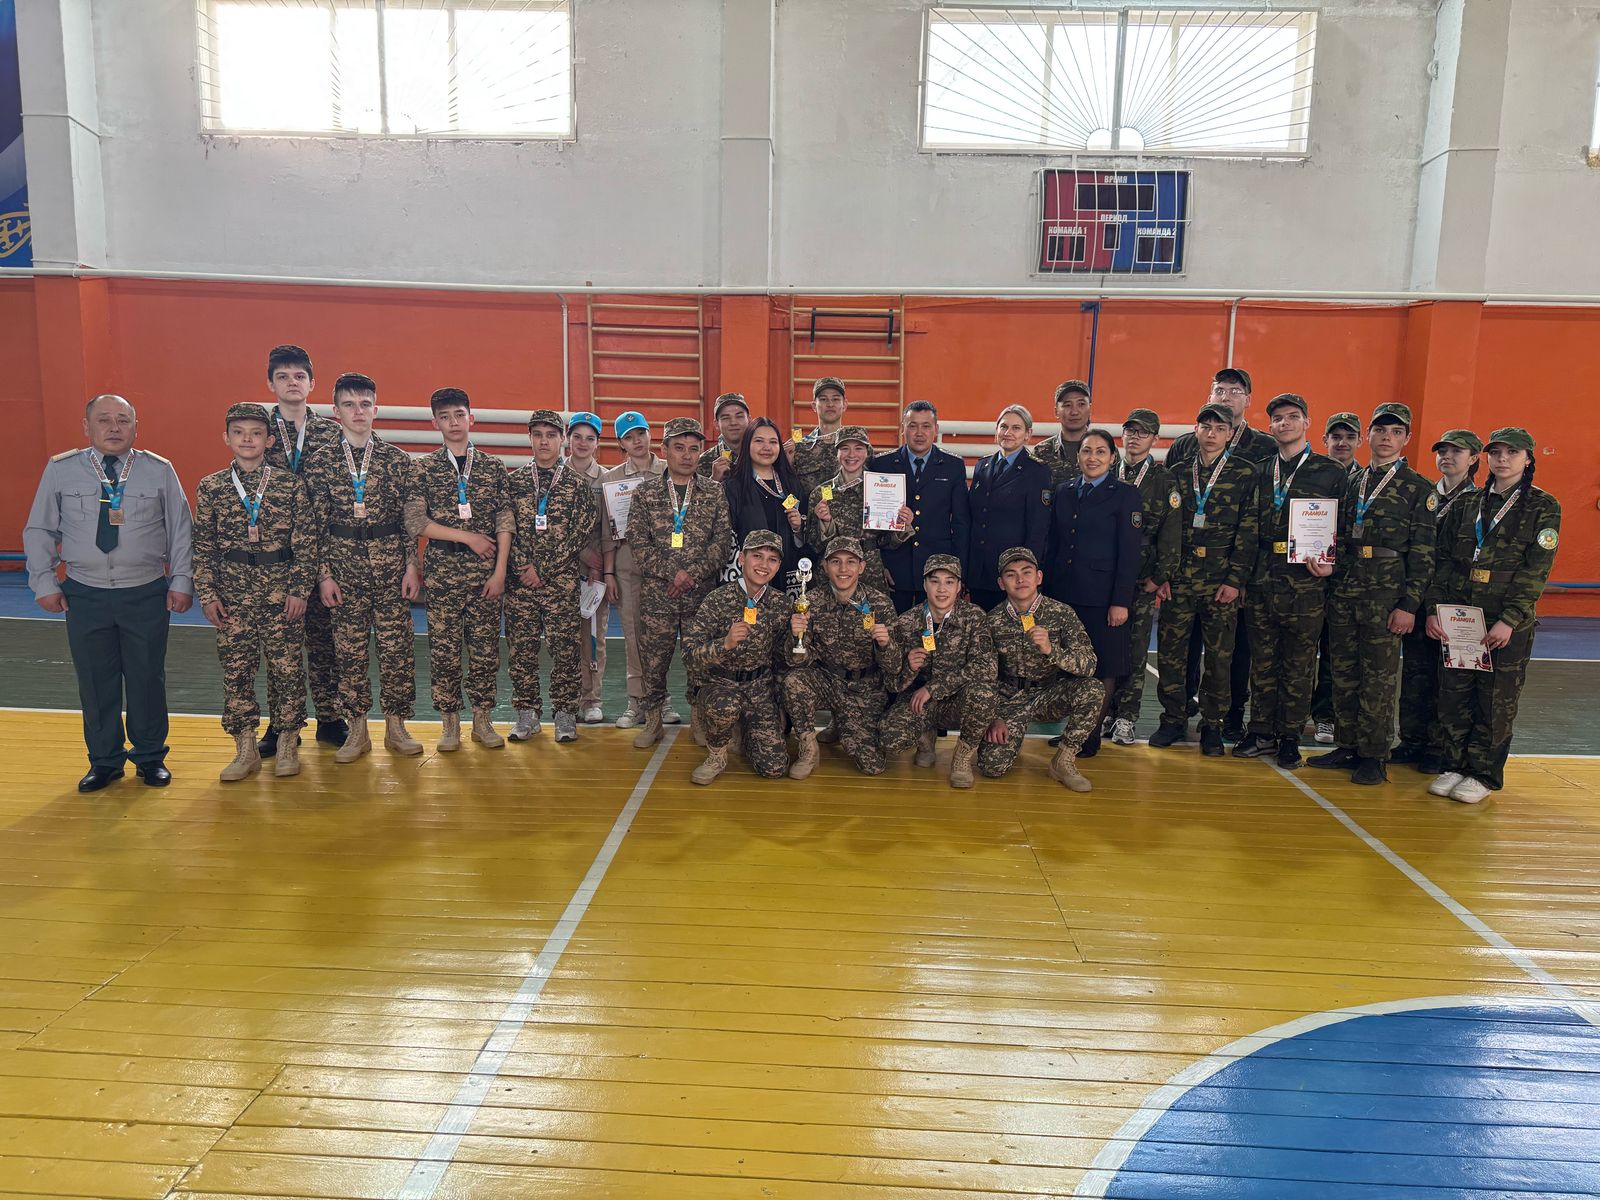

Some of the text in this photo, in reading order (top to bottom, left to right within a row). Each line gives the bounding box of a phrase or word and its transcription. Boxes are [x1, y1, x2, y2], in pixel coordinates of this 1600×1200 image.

[1104, 175, 1128, 184] ВРЕМЯ
[1100, 214, 1128, 223] ПЕРИОД
[1048, 226, 1083, 235] КОМАНДА
[1137, 227, 1171, 236] КОМАНДА
